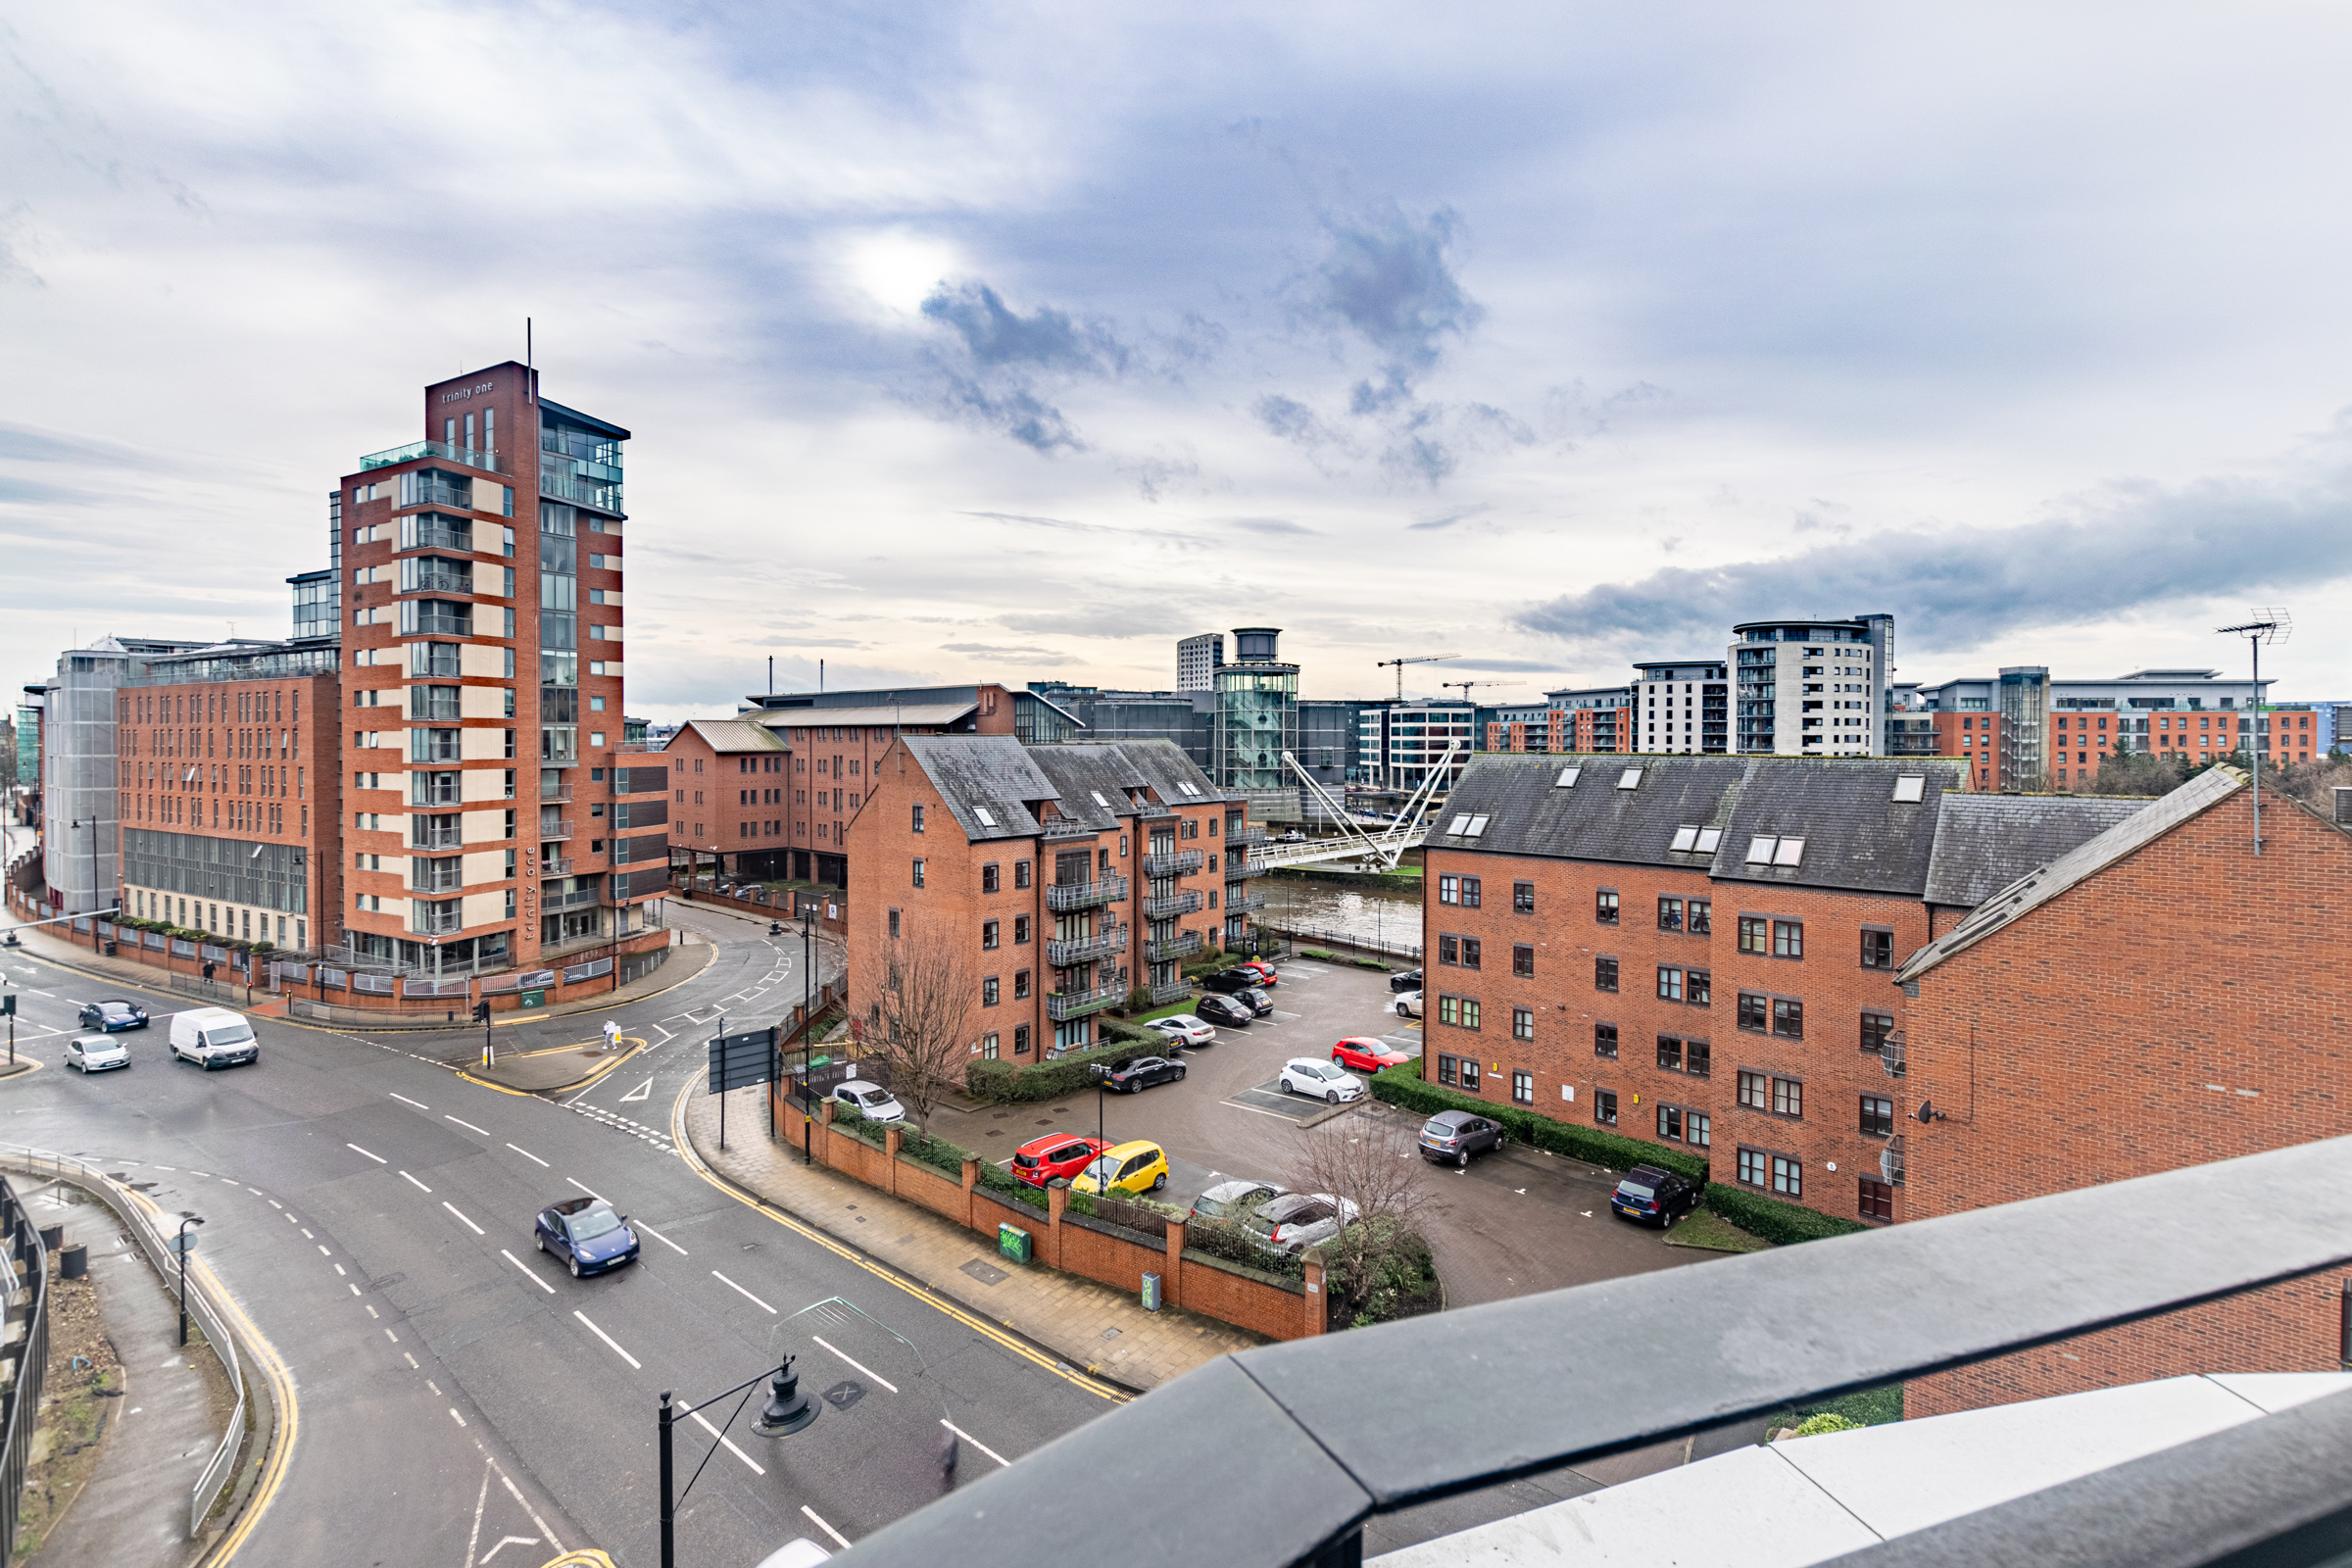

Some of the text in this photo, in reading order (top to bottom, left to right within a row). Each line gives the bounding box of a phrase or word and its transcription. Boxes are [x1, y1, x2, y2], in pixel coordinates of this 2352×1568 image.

[442, 382, 493, 404] trinity one
[525, 847, 537, 941] trinity one
